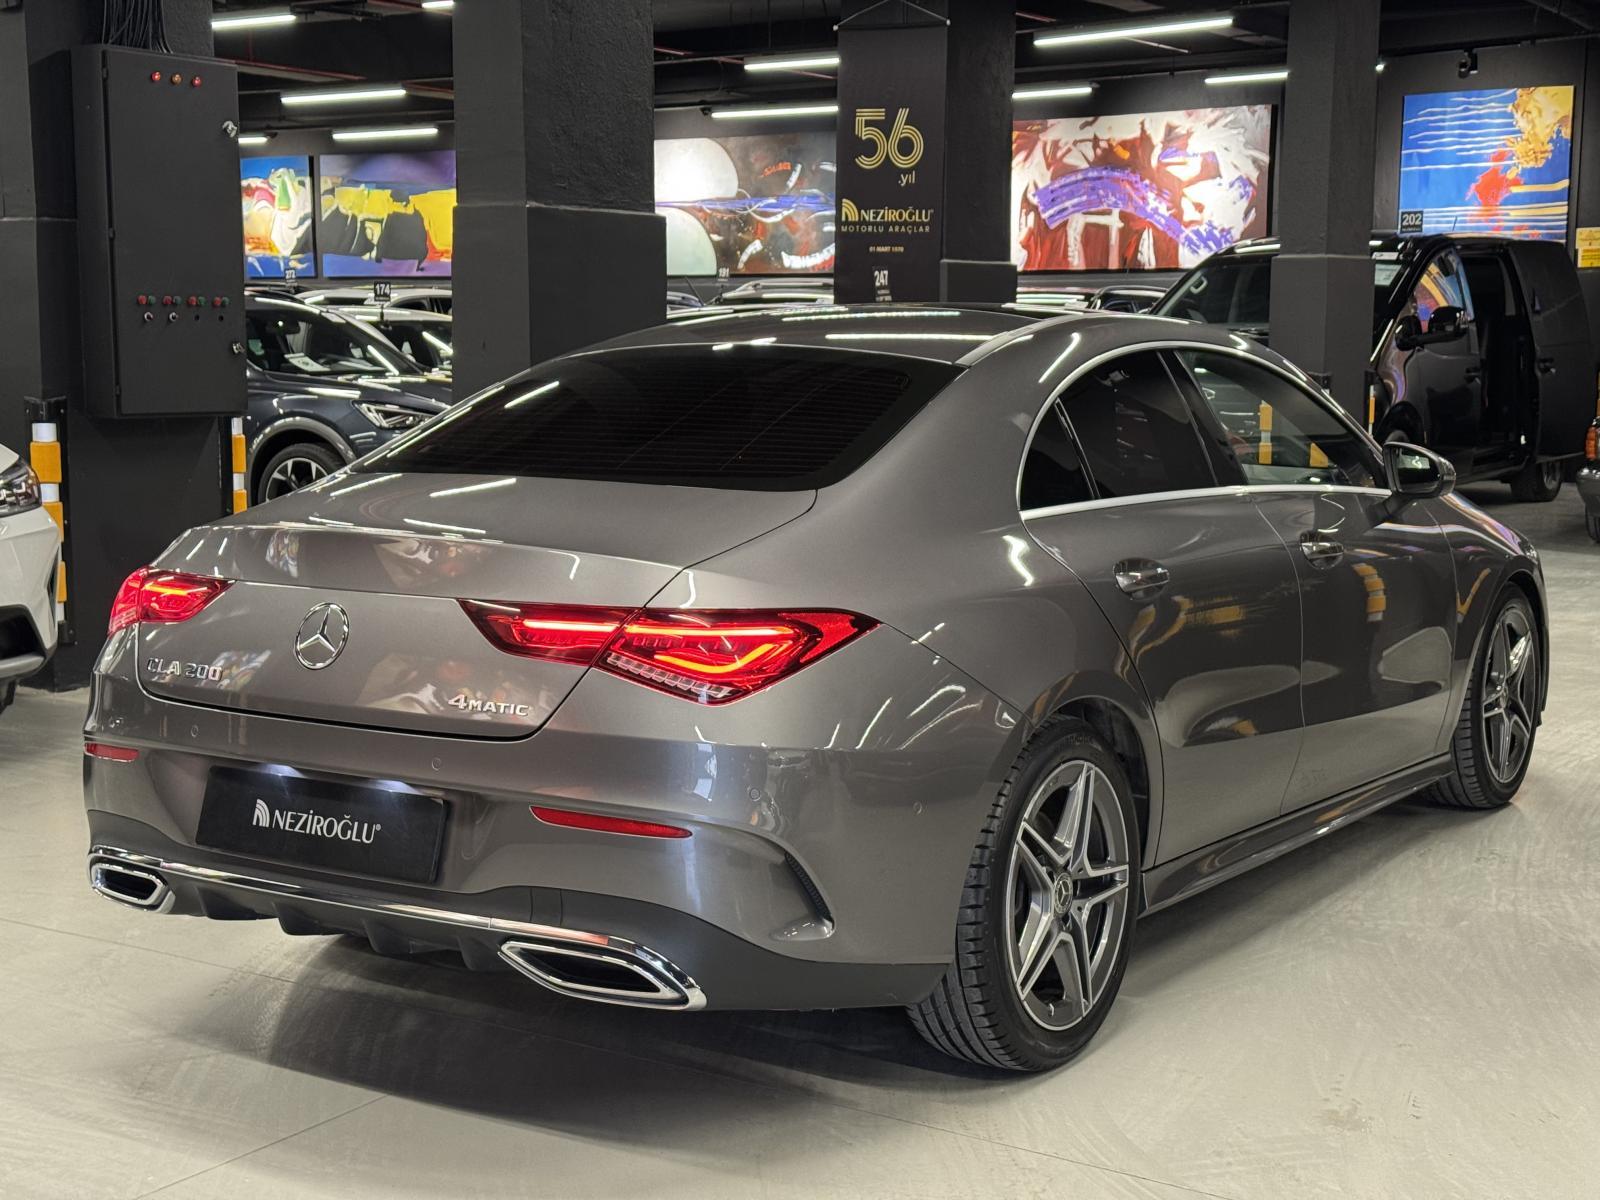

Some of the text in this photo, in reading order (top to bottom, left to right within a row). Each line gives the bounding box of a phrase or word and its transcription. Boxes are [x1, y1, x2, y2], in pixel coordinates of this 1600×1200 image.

[855, 107, 924, 169] 56
[1402, 213, 1422, 226] 202
[841, 225, 930, 235] MOTORLU ARAÇLAR
[874, 270, 889, 286] 247
[375, 283, 390, 296] 174
[147, 657, 223, 681] CLA 200
[448, 694, 529, 716] 4MATIC
